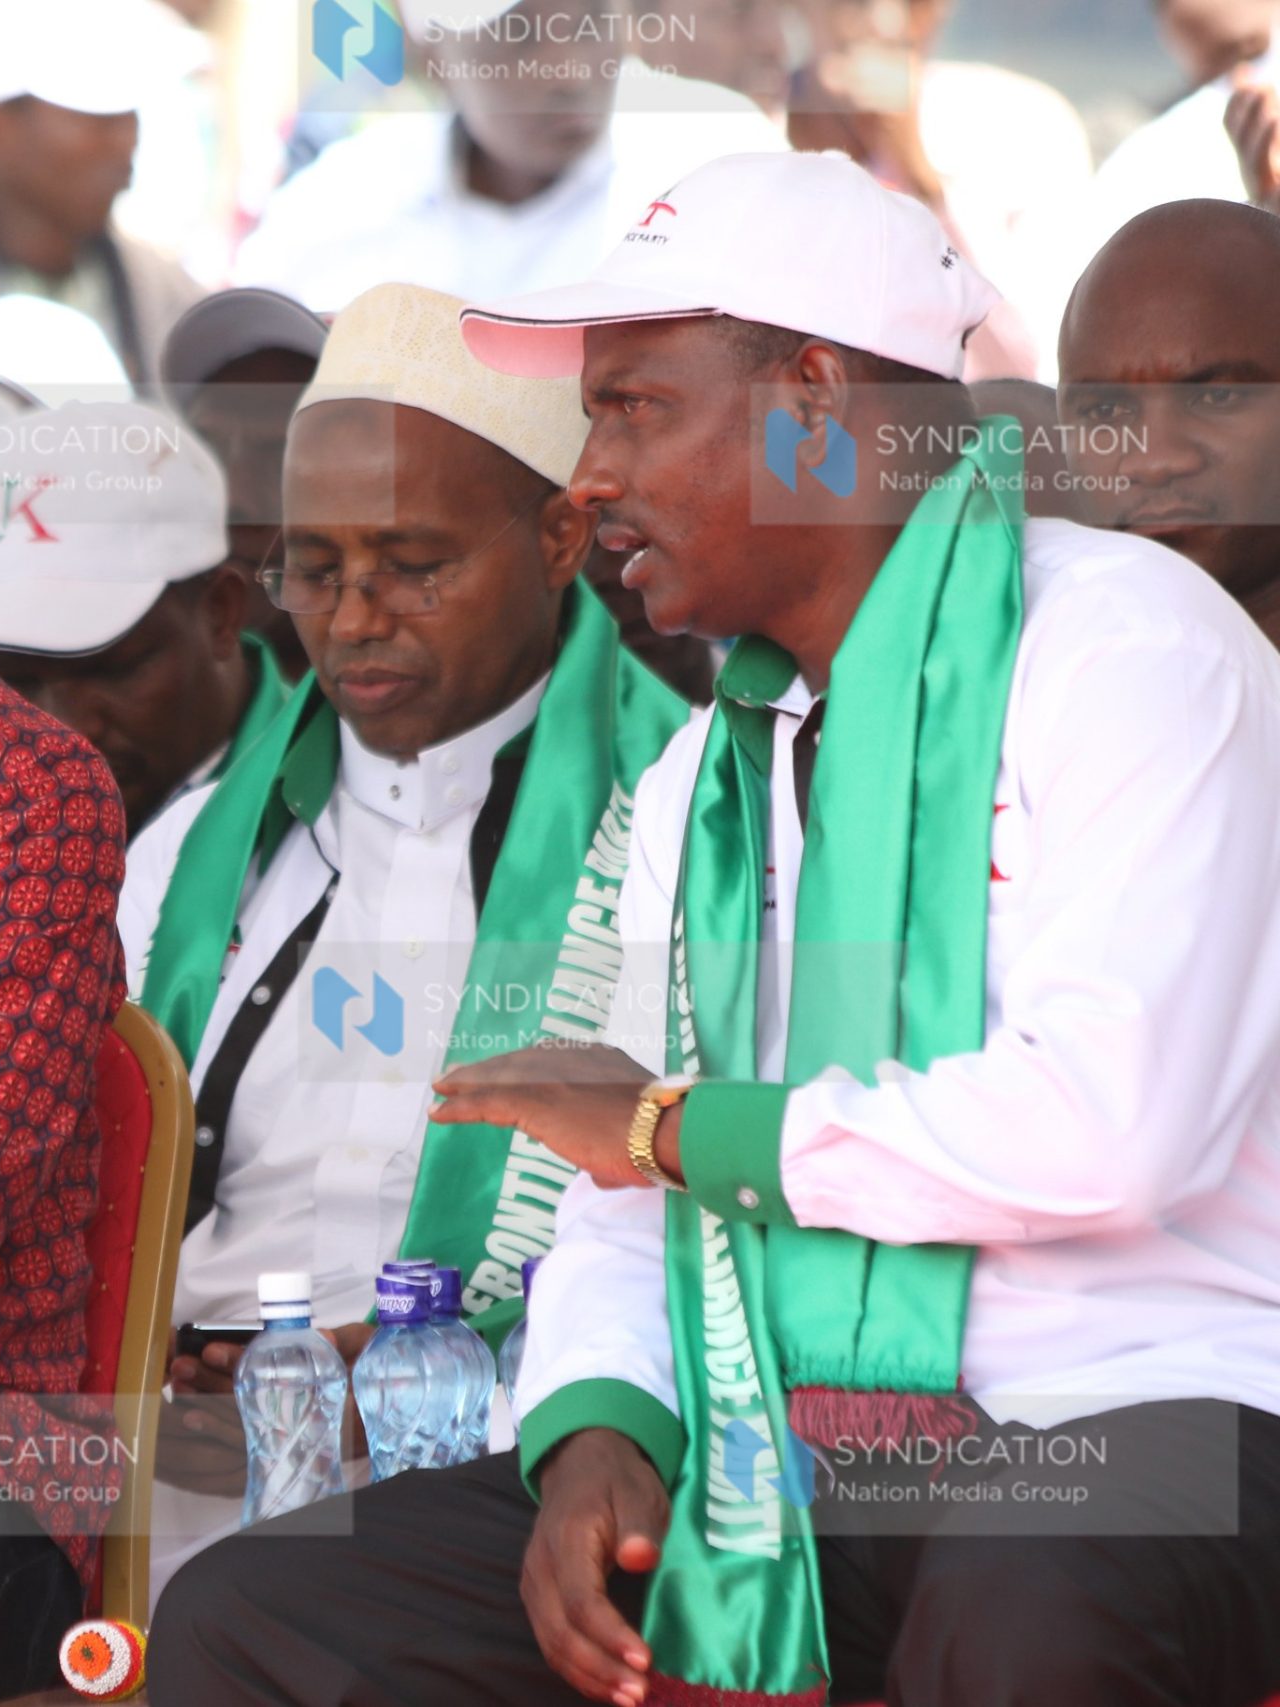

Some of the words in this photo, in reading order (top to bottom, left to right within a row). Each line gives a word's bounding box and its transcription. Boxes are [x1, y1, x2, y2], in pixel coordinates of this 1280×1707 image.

[461, 1130, 580, 1315] FRONTIE
[540, 875, 624, 1043] LIANCE
[700, 1206, 762, 1406] LLIANCE
[706, 1409, 783, 1561] PARTY
